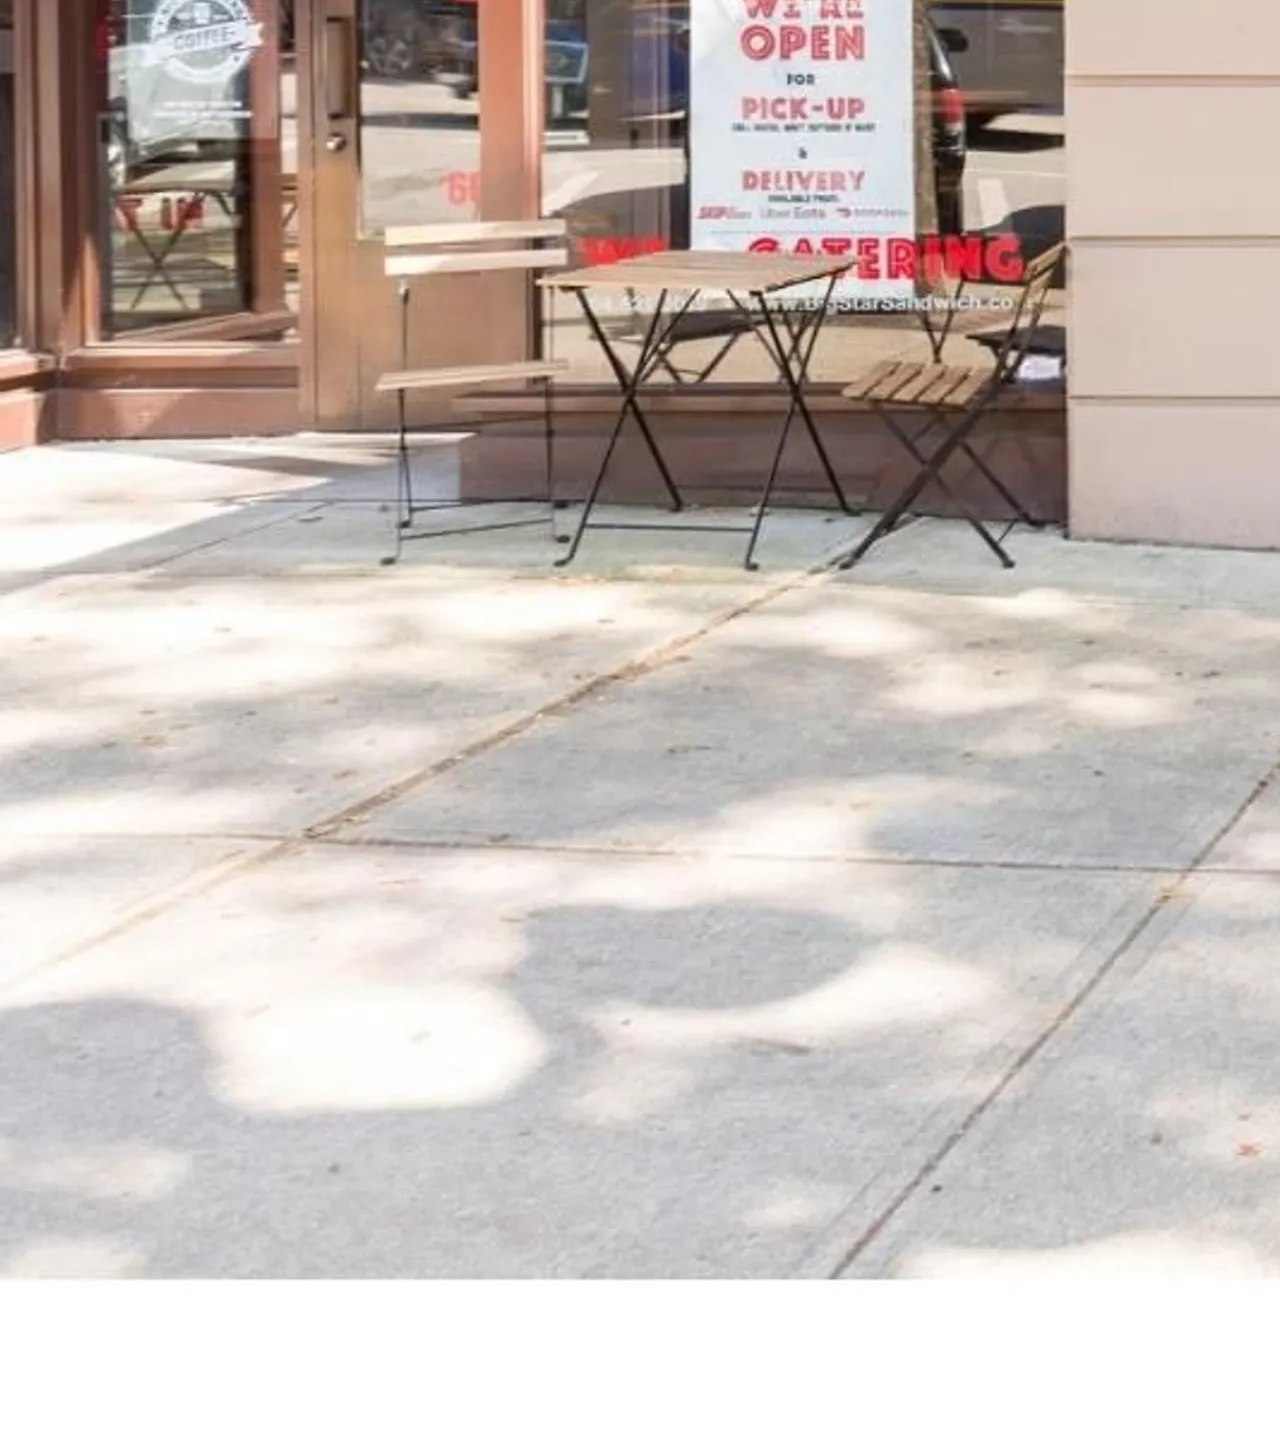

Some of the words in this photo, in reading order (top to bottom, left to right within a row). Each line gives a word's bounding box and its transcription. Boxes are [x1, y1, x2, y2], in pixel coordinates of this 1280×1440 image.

[740, 25, 865, 61] OPEN
[787, 73, 816, 86] FOR
[742, 97, 865, 120] PICK-UP
[742, 171, 865, 192] DELIVERY
